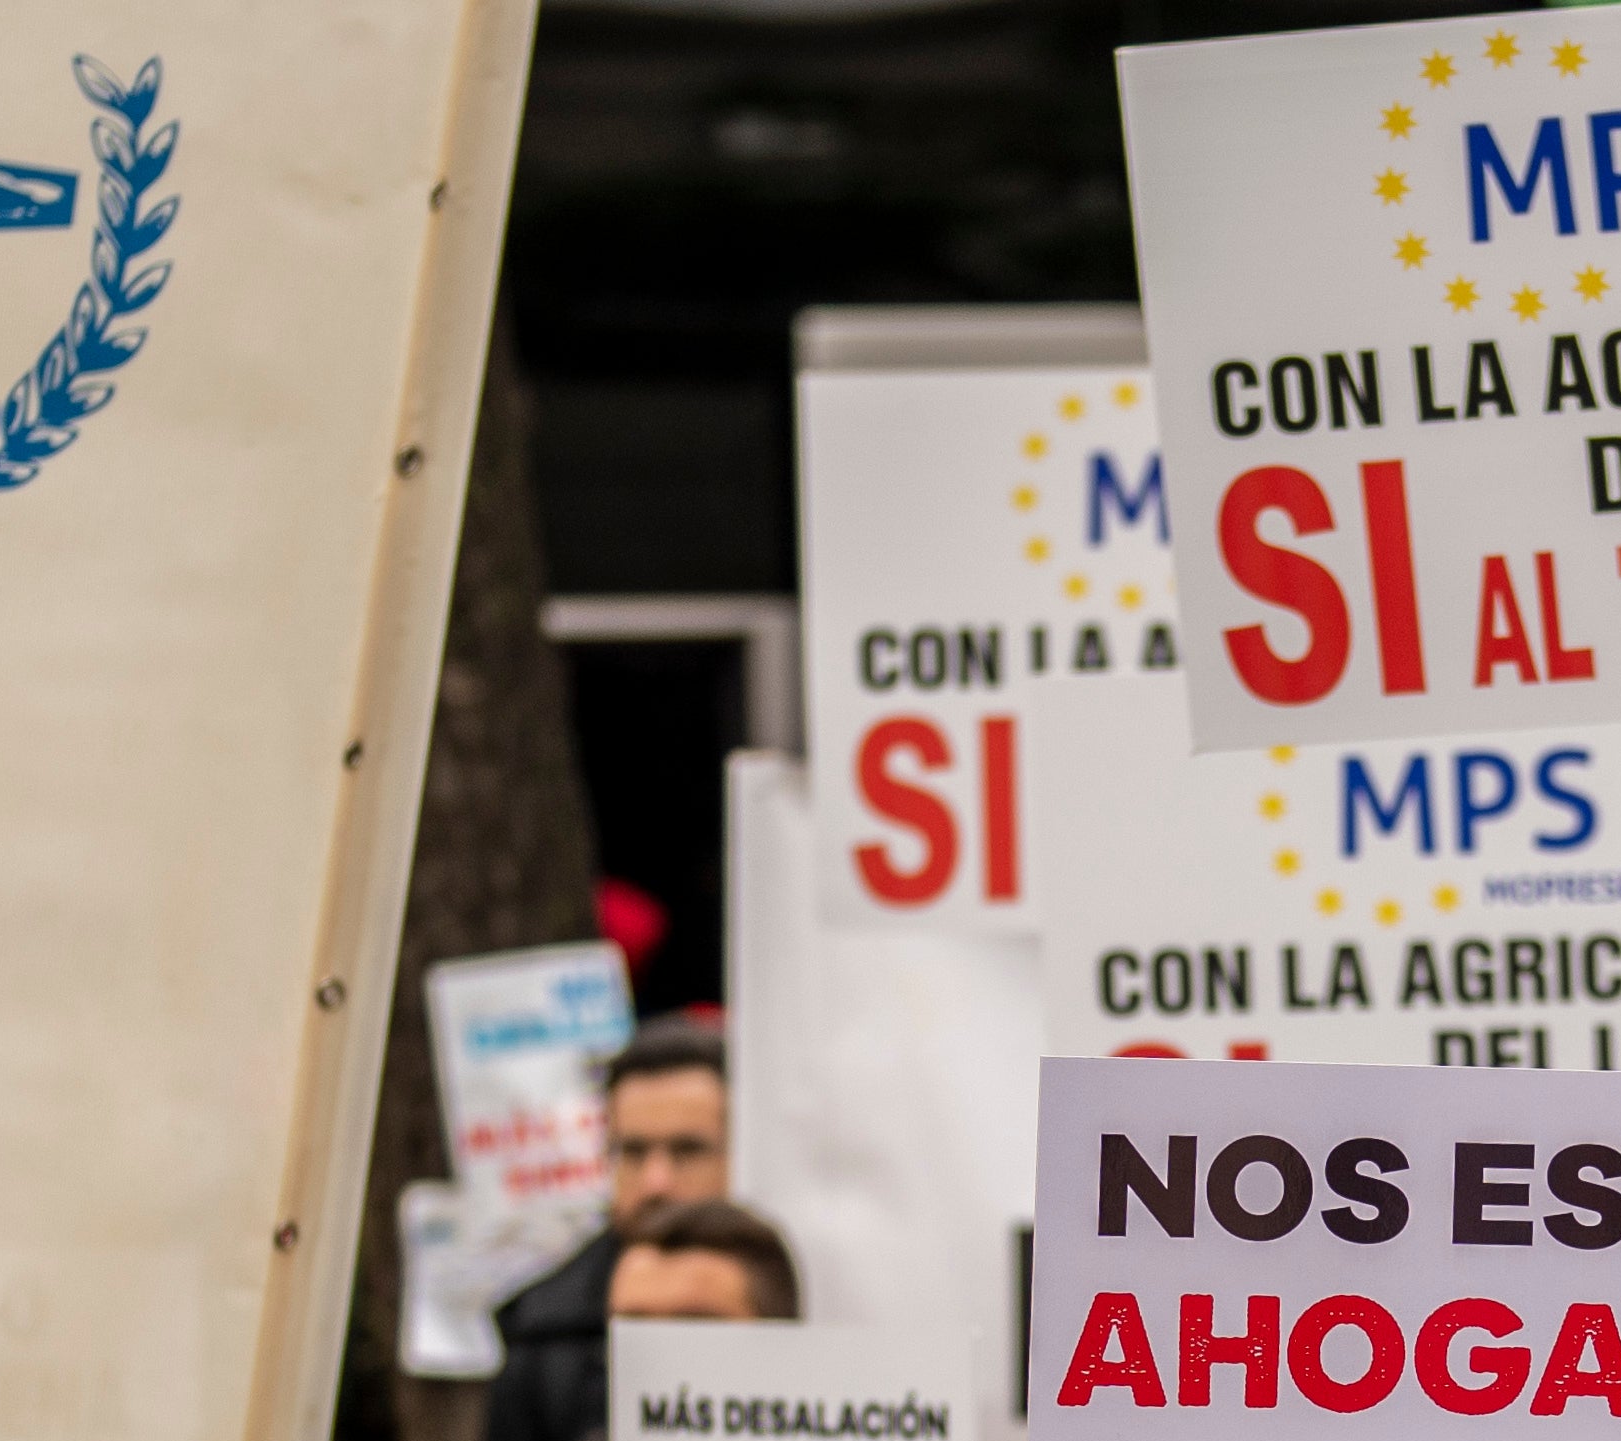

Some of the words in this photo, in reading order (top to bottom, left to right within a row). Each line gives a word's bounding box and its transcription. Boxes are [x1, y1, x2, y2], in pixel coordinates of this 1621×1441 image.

[1210, 346, 1383, 438] CON
[1414, 339, 1518, 422] LA
[1217, 457, 1428, 707] SI
[1473, 549, 1596, 688] AL
[857, 624, 1003, 692] CON
[853, 710, 1023, 911] SI
[1338, 749, 1601, 860] MPS
[1098, 945, 1252, 1016] CON
[1281, 943, 1372, 1012] LA
[1097, 1132, 1411, 1244] NOS
[640, 1384, 716, 1435] MÁS
[724, 1391, 950, 1441] DESALACIÓN
